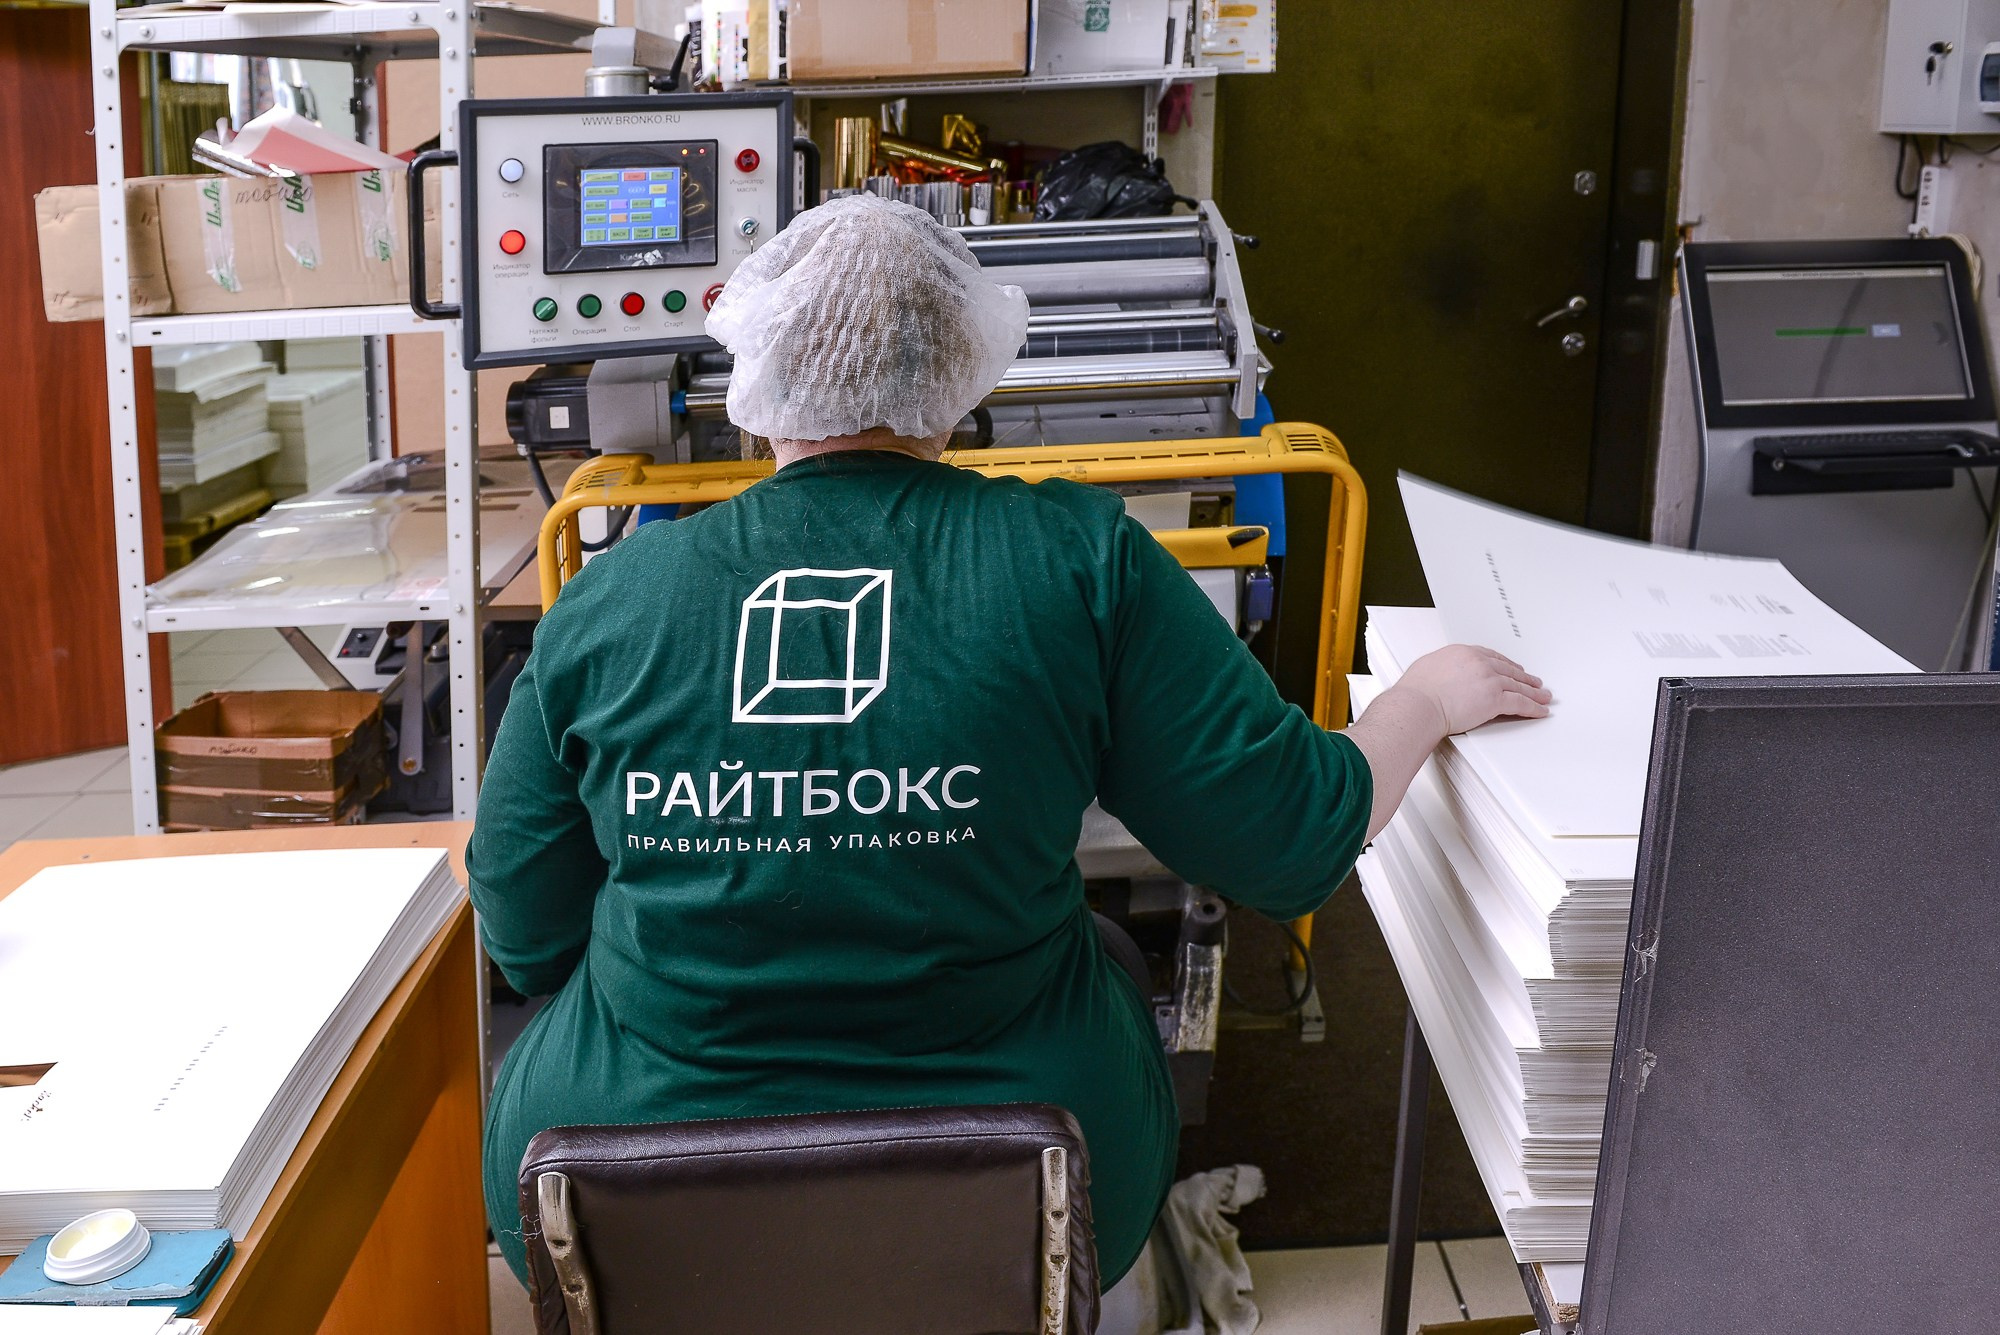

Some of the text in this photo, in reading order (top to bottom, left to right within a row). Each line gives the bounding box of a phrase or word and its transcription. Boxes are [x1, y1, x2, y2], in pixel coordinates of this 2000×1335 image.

[581, 114, 681, 126] WWW.BRONKO.RU
[729, 178, 765, 186] Индикатор
[493, 263, 531, 271] Индикатор
[529, 327, 559, 336] Натяжка
[572, 327, 607, 336] Операция
[531, 336, 557, 344] фольги
[626, 760, 981, 817] РАЙТБОКС
[628, 826, 976, 853] ПРАВИЛЬНАЯ УПАКОВКА
